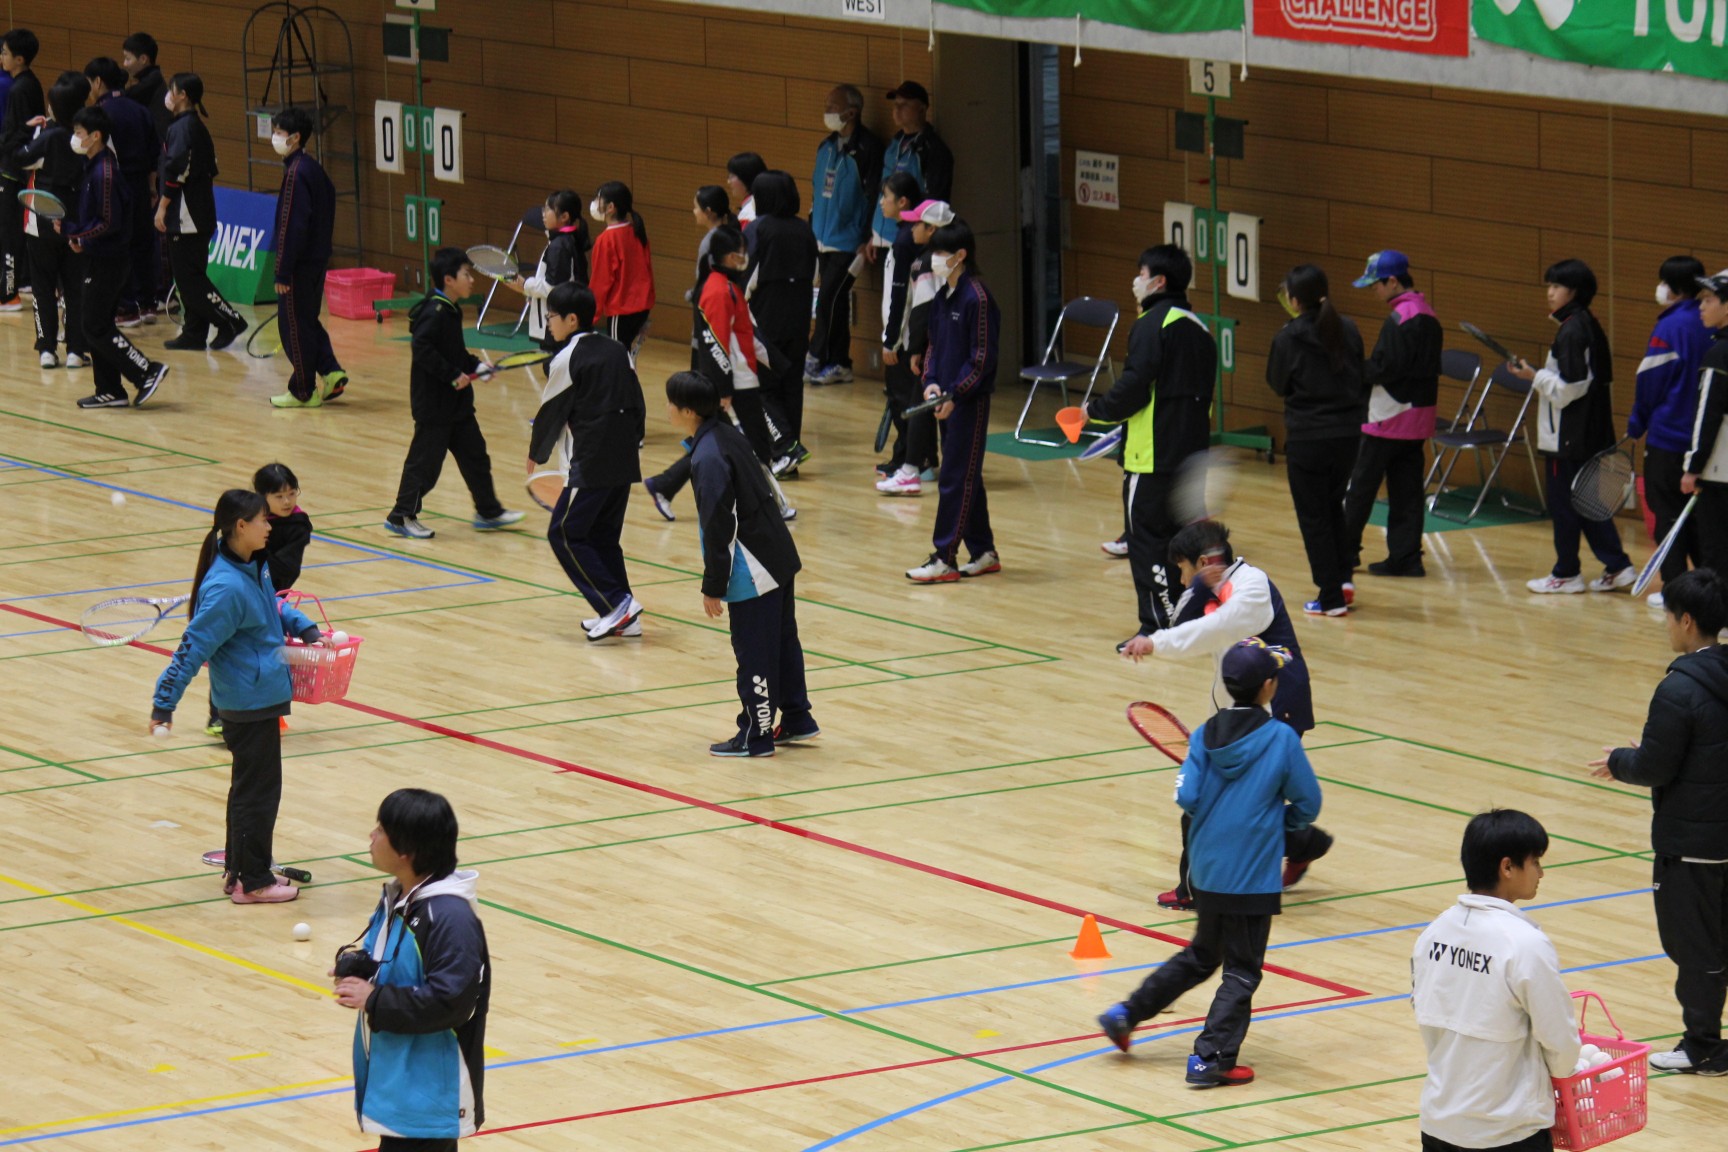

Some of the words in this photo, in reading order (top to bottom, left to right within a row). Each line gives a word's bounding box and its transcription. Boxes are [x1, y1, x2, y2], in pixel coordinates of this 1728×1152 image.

[1287, 0, 1431, 31] CHALLENGE
[1203, 61, 1215, 93] 5
[382, 116, 394, 162] 0
[405, 113, 415, 149] 0
[423, 116, 433, 151] 0
[441, 125, 454, 171] 0
[407, 203, 416, 239] 0
[428, 206, 439, 242] 0
[1196, 218, 1208, 259] 0
[1215, 220, 1228, 261] 0
[1236, 232, 1249, 287] 0
[127, 345, 150, 371] YONEX
[1221, 327, 1233, 369] 0
[1450, 946, 1492, 974] YONEX
